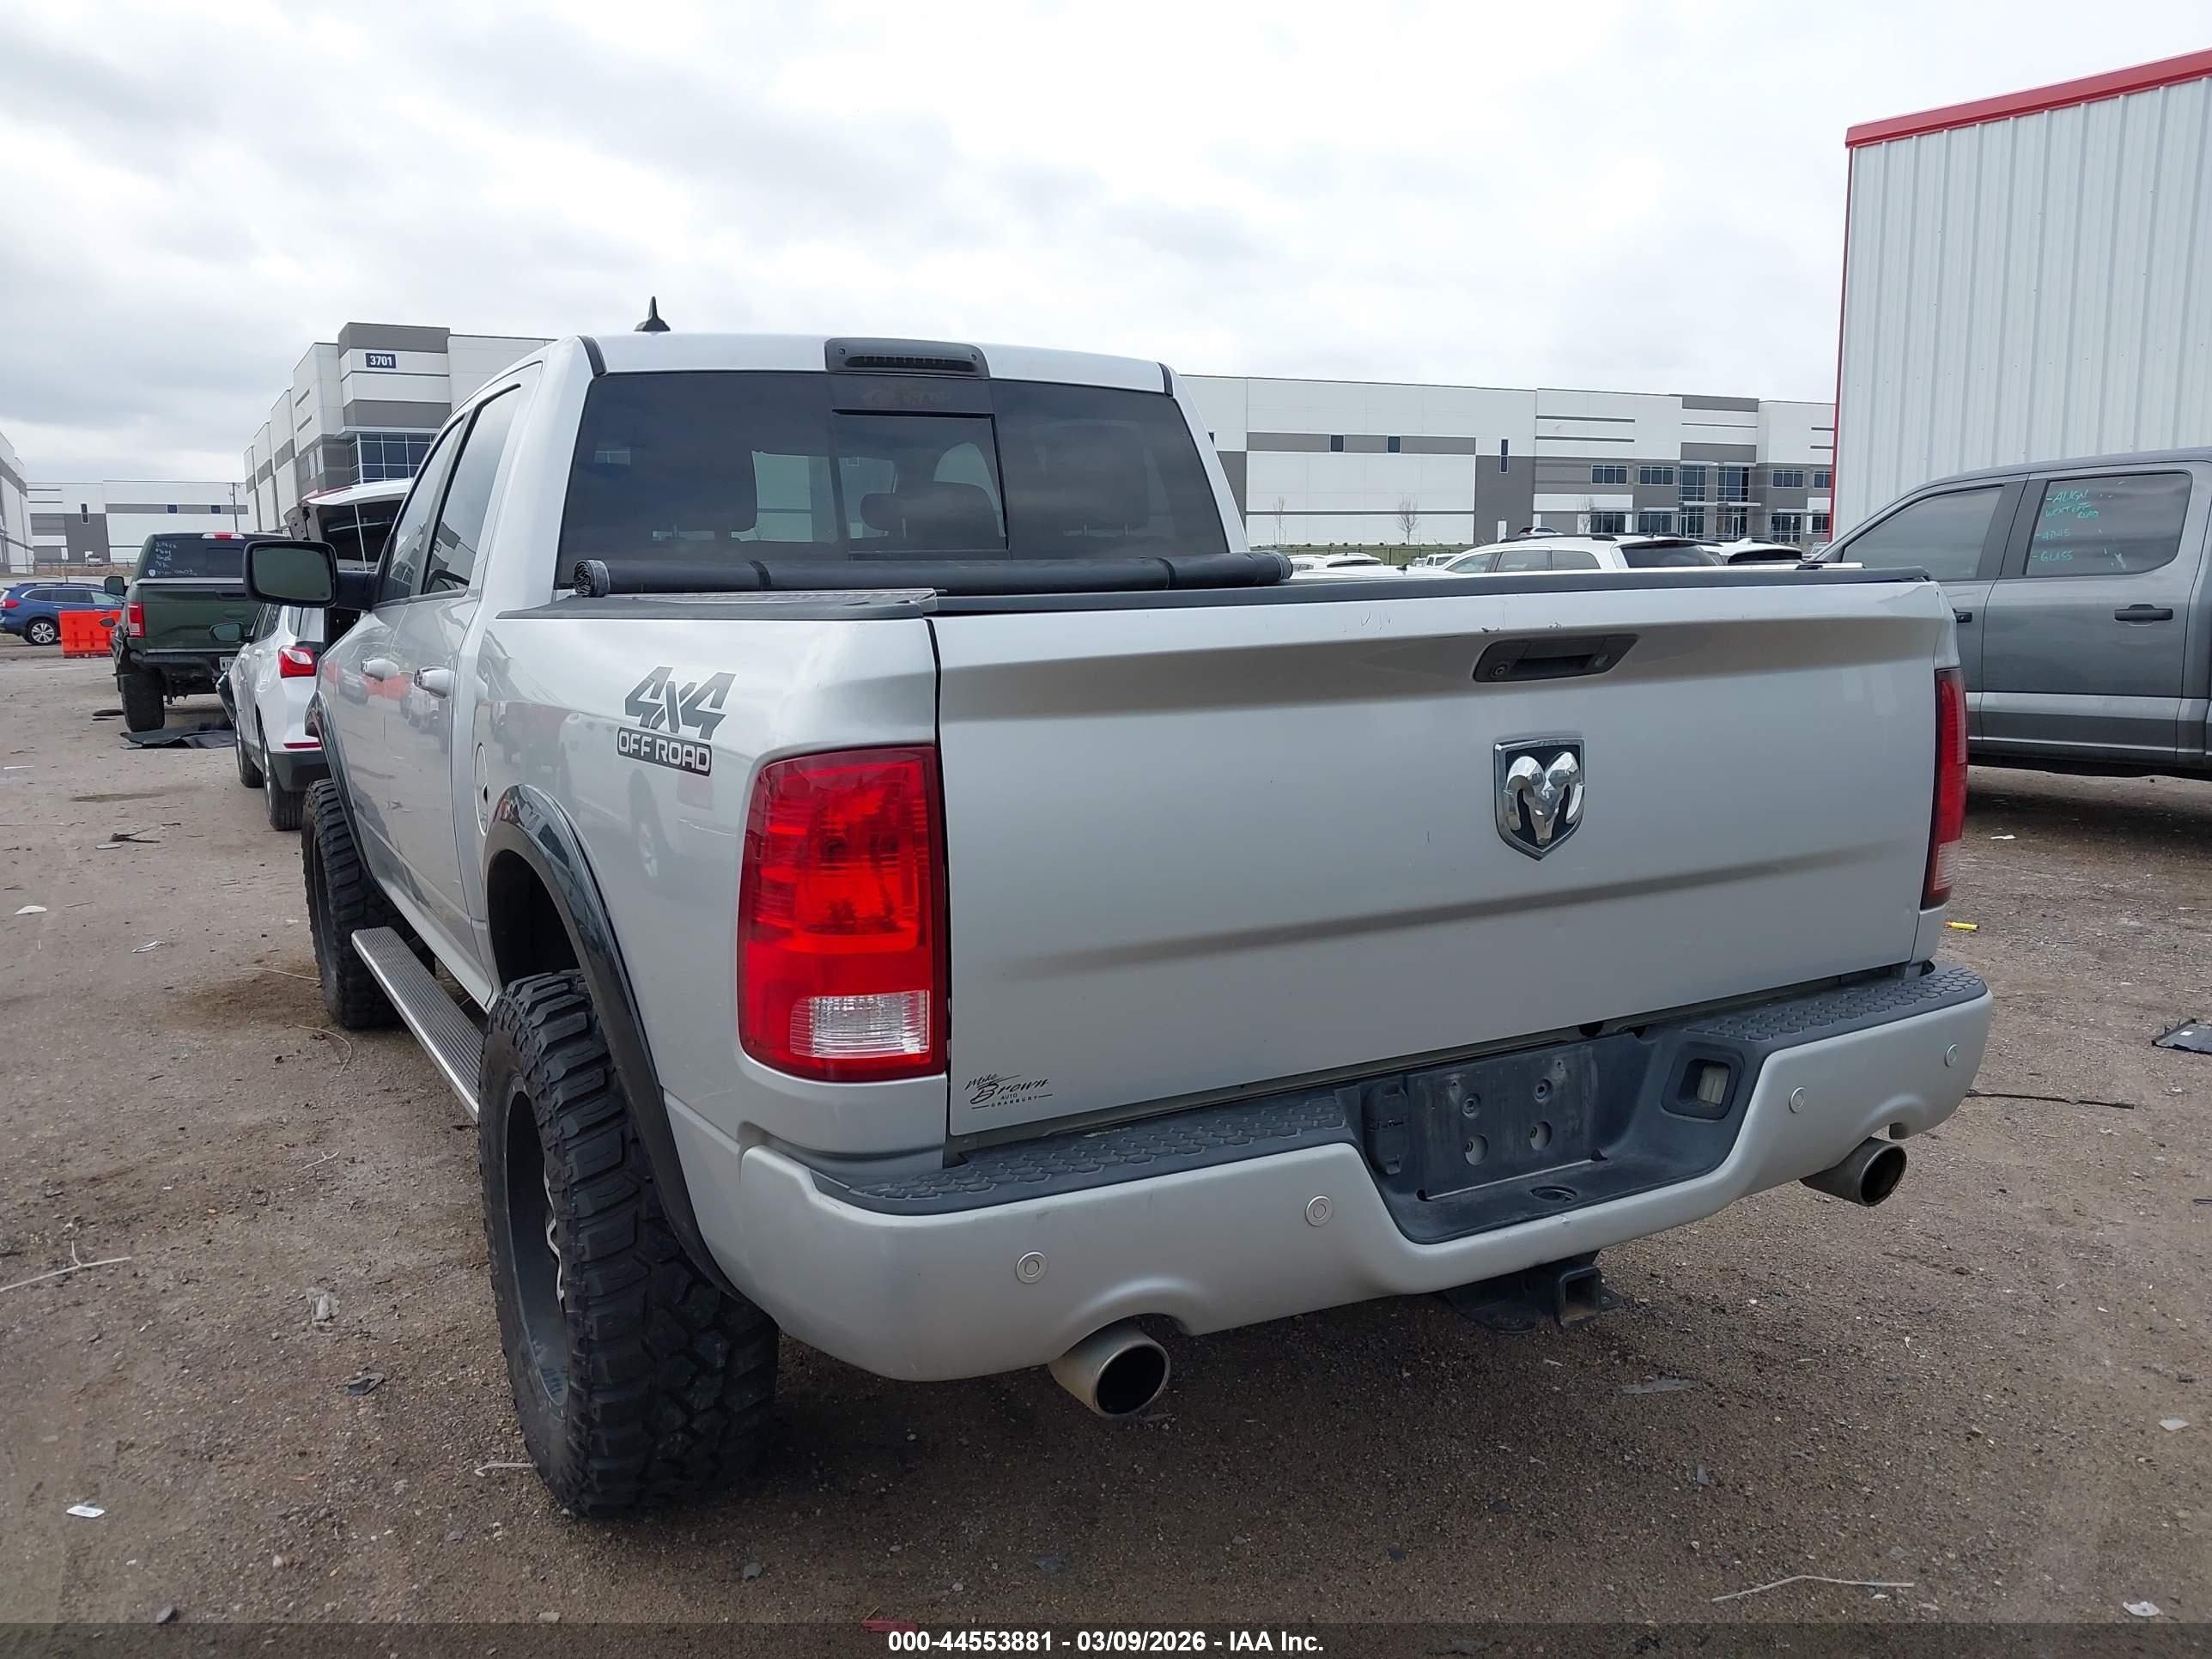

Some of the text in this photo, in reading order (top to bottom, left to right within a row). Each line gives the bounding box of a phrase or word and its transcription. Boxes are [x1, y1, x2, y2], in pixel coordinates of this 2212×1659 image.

[369, 355, 392, 367] 3701
[618, 730, 712, 772] OFF ROAD
[969, 1079, 1049, 1105] Brown
[1000, 1092, 1018, 1101] AUTO
